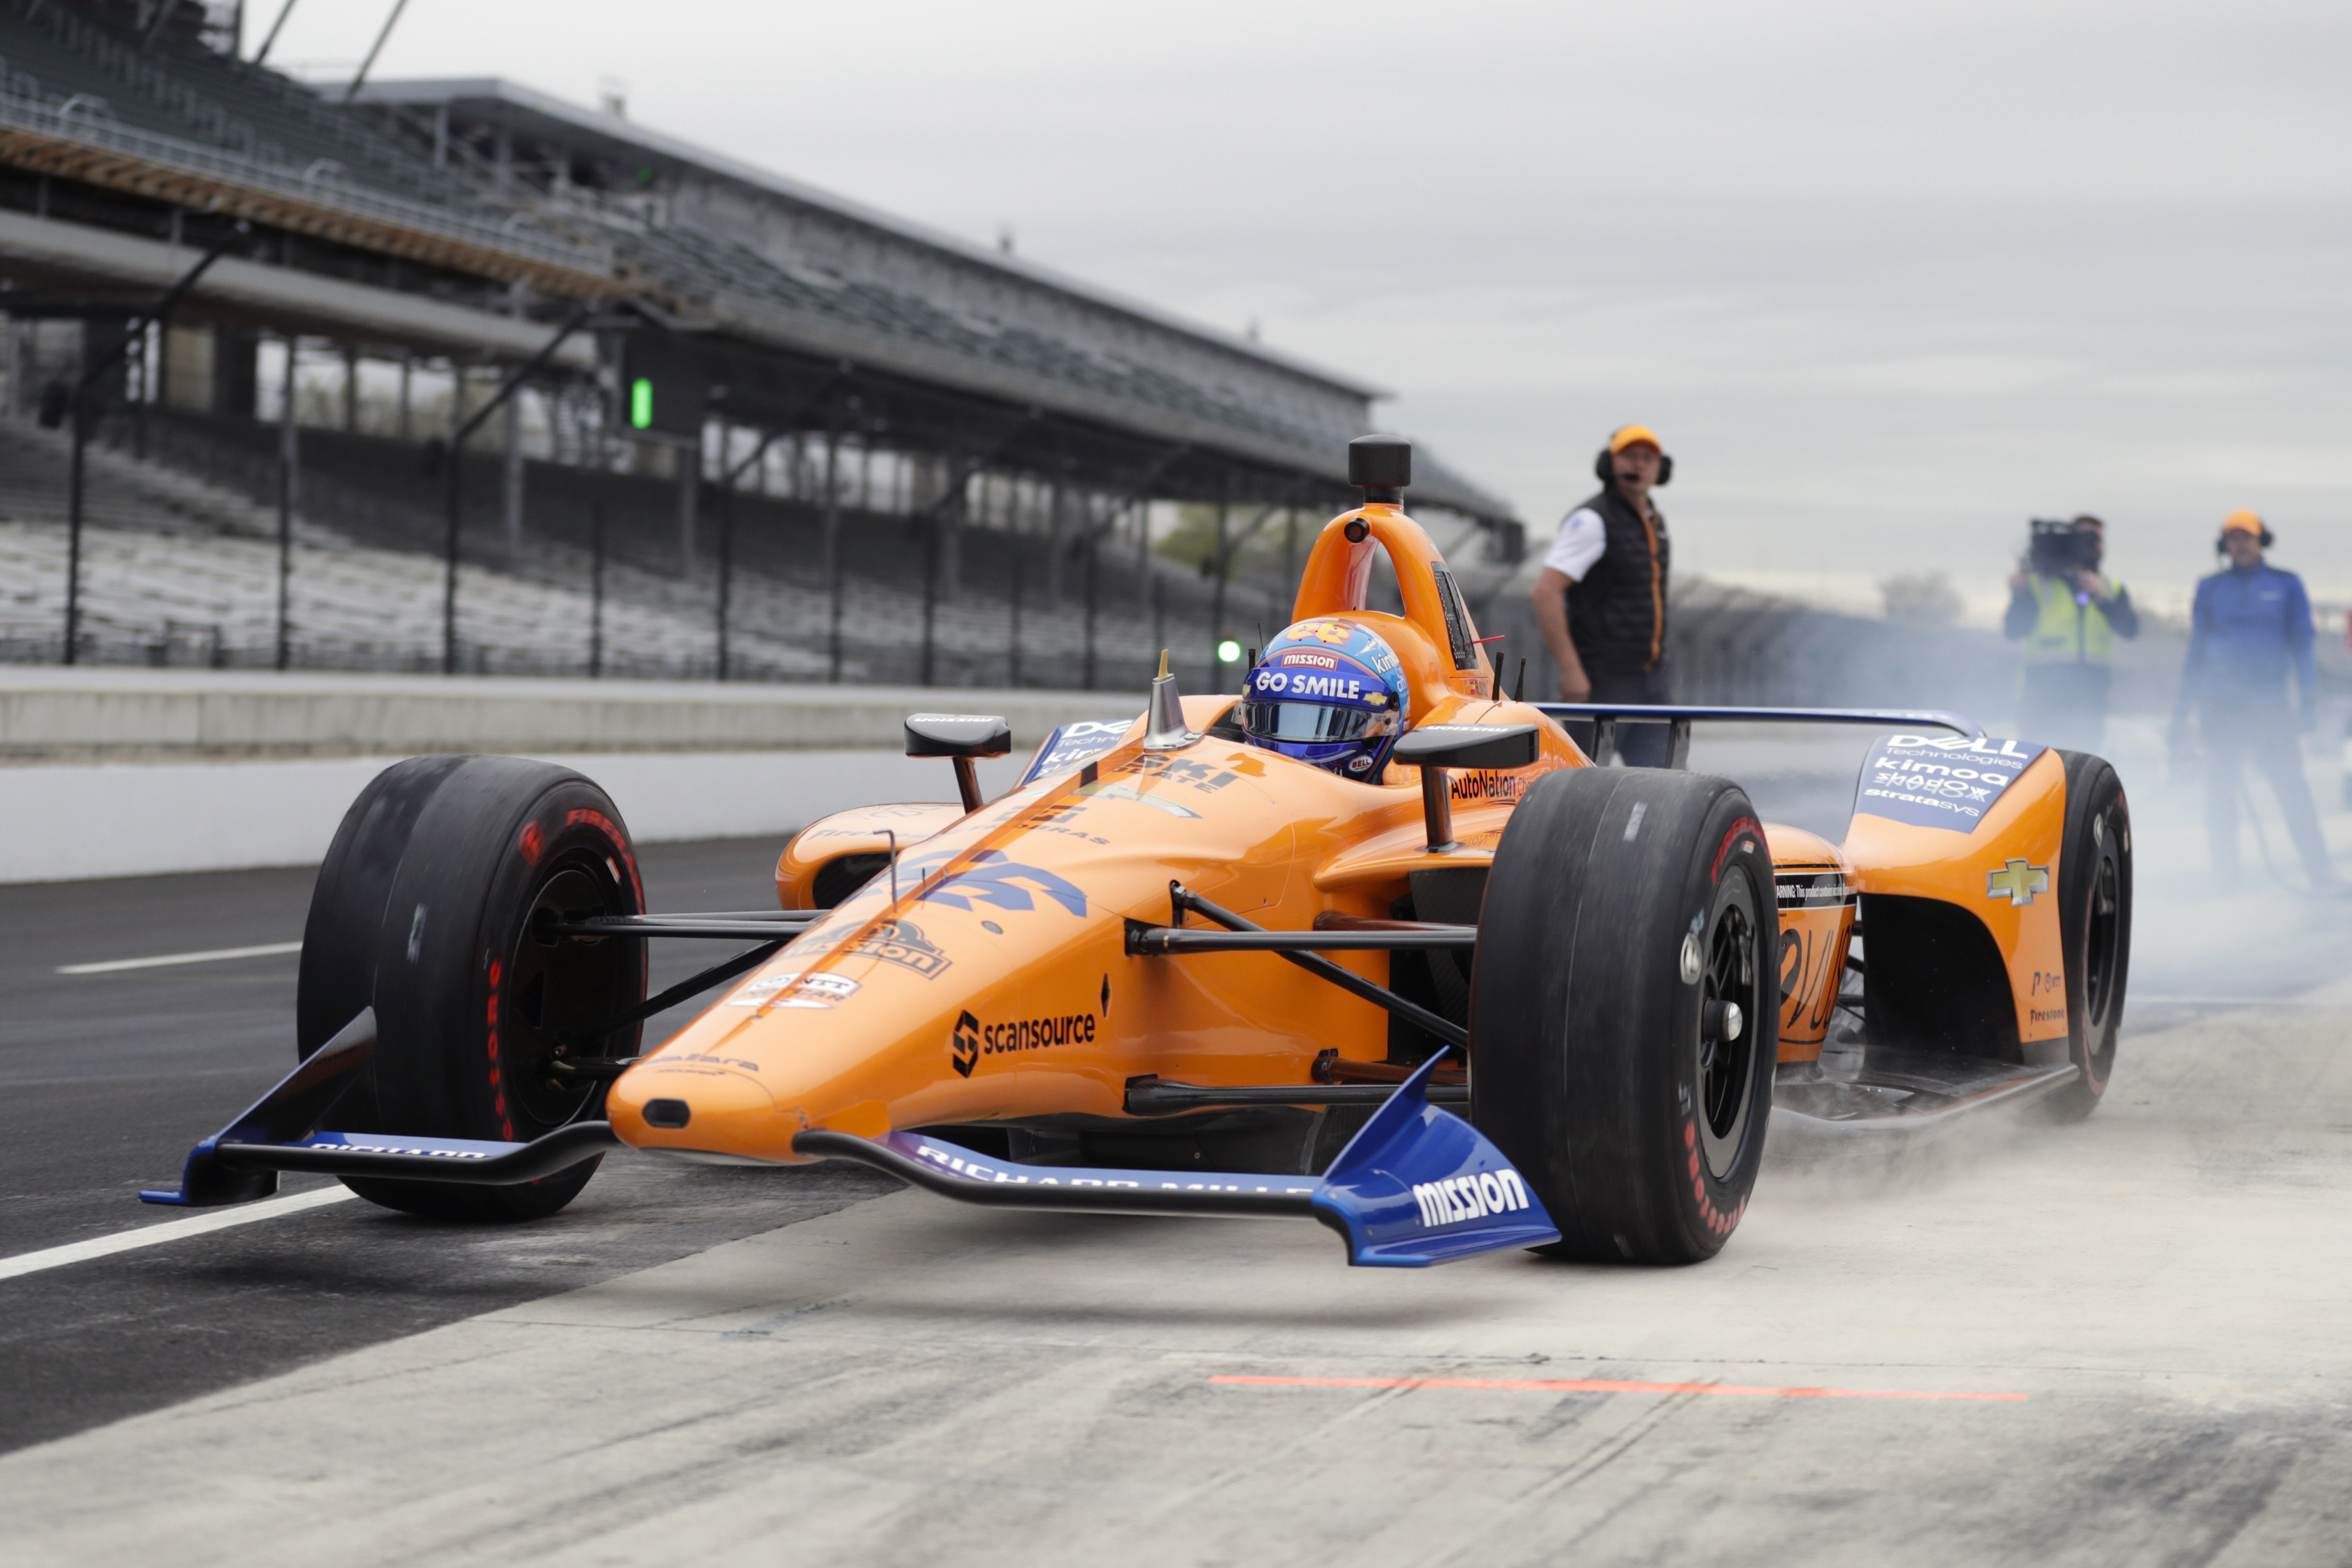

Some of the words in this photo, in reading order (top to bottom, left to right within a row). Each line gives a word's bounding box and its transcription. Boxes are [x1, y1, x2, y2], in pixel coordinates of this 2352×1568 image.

[1283, 654, 1335, 668] mission
[1256, 671, 1288, 692] GO
[1291, 675, 1360, 699] SMILE
[1884, 747, 2024, 770] Technologies
[1887, 734, 2029, 759] DELL
[1352, 758, 1371, 769] BELL
[1874, 757, 2010, 787] kimoa
[1451, 770, 1516, 799] AutoNation
[1864, 788, 1980, 817] stratasys
[984, 1013, 1095, 1054] scansource
[1412, 1168, 1530, 1228] mission
